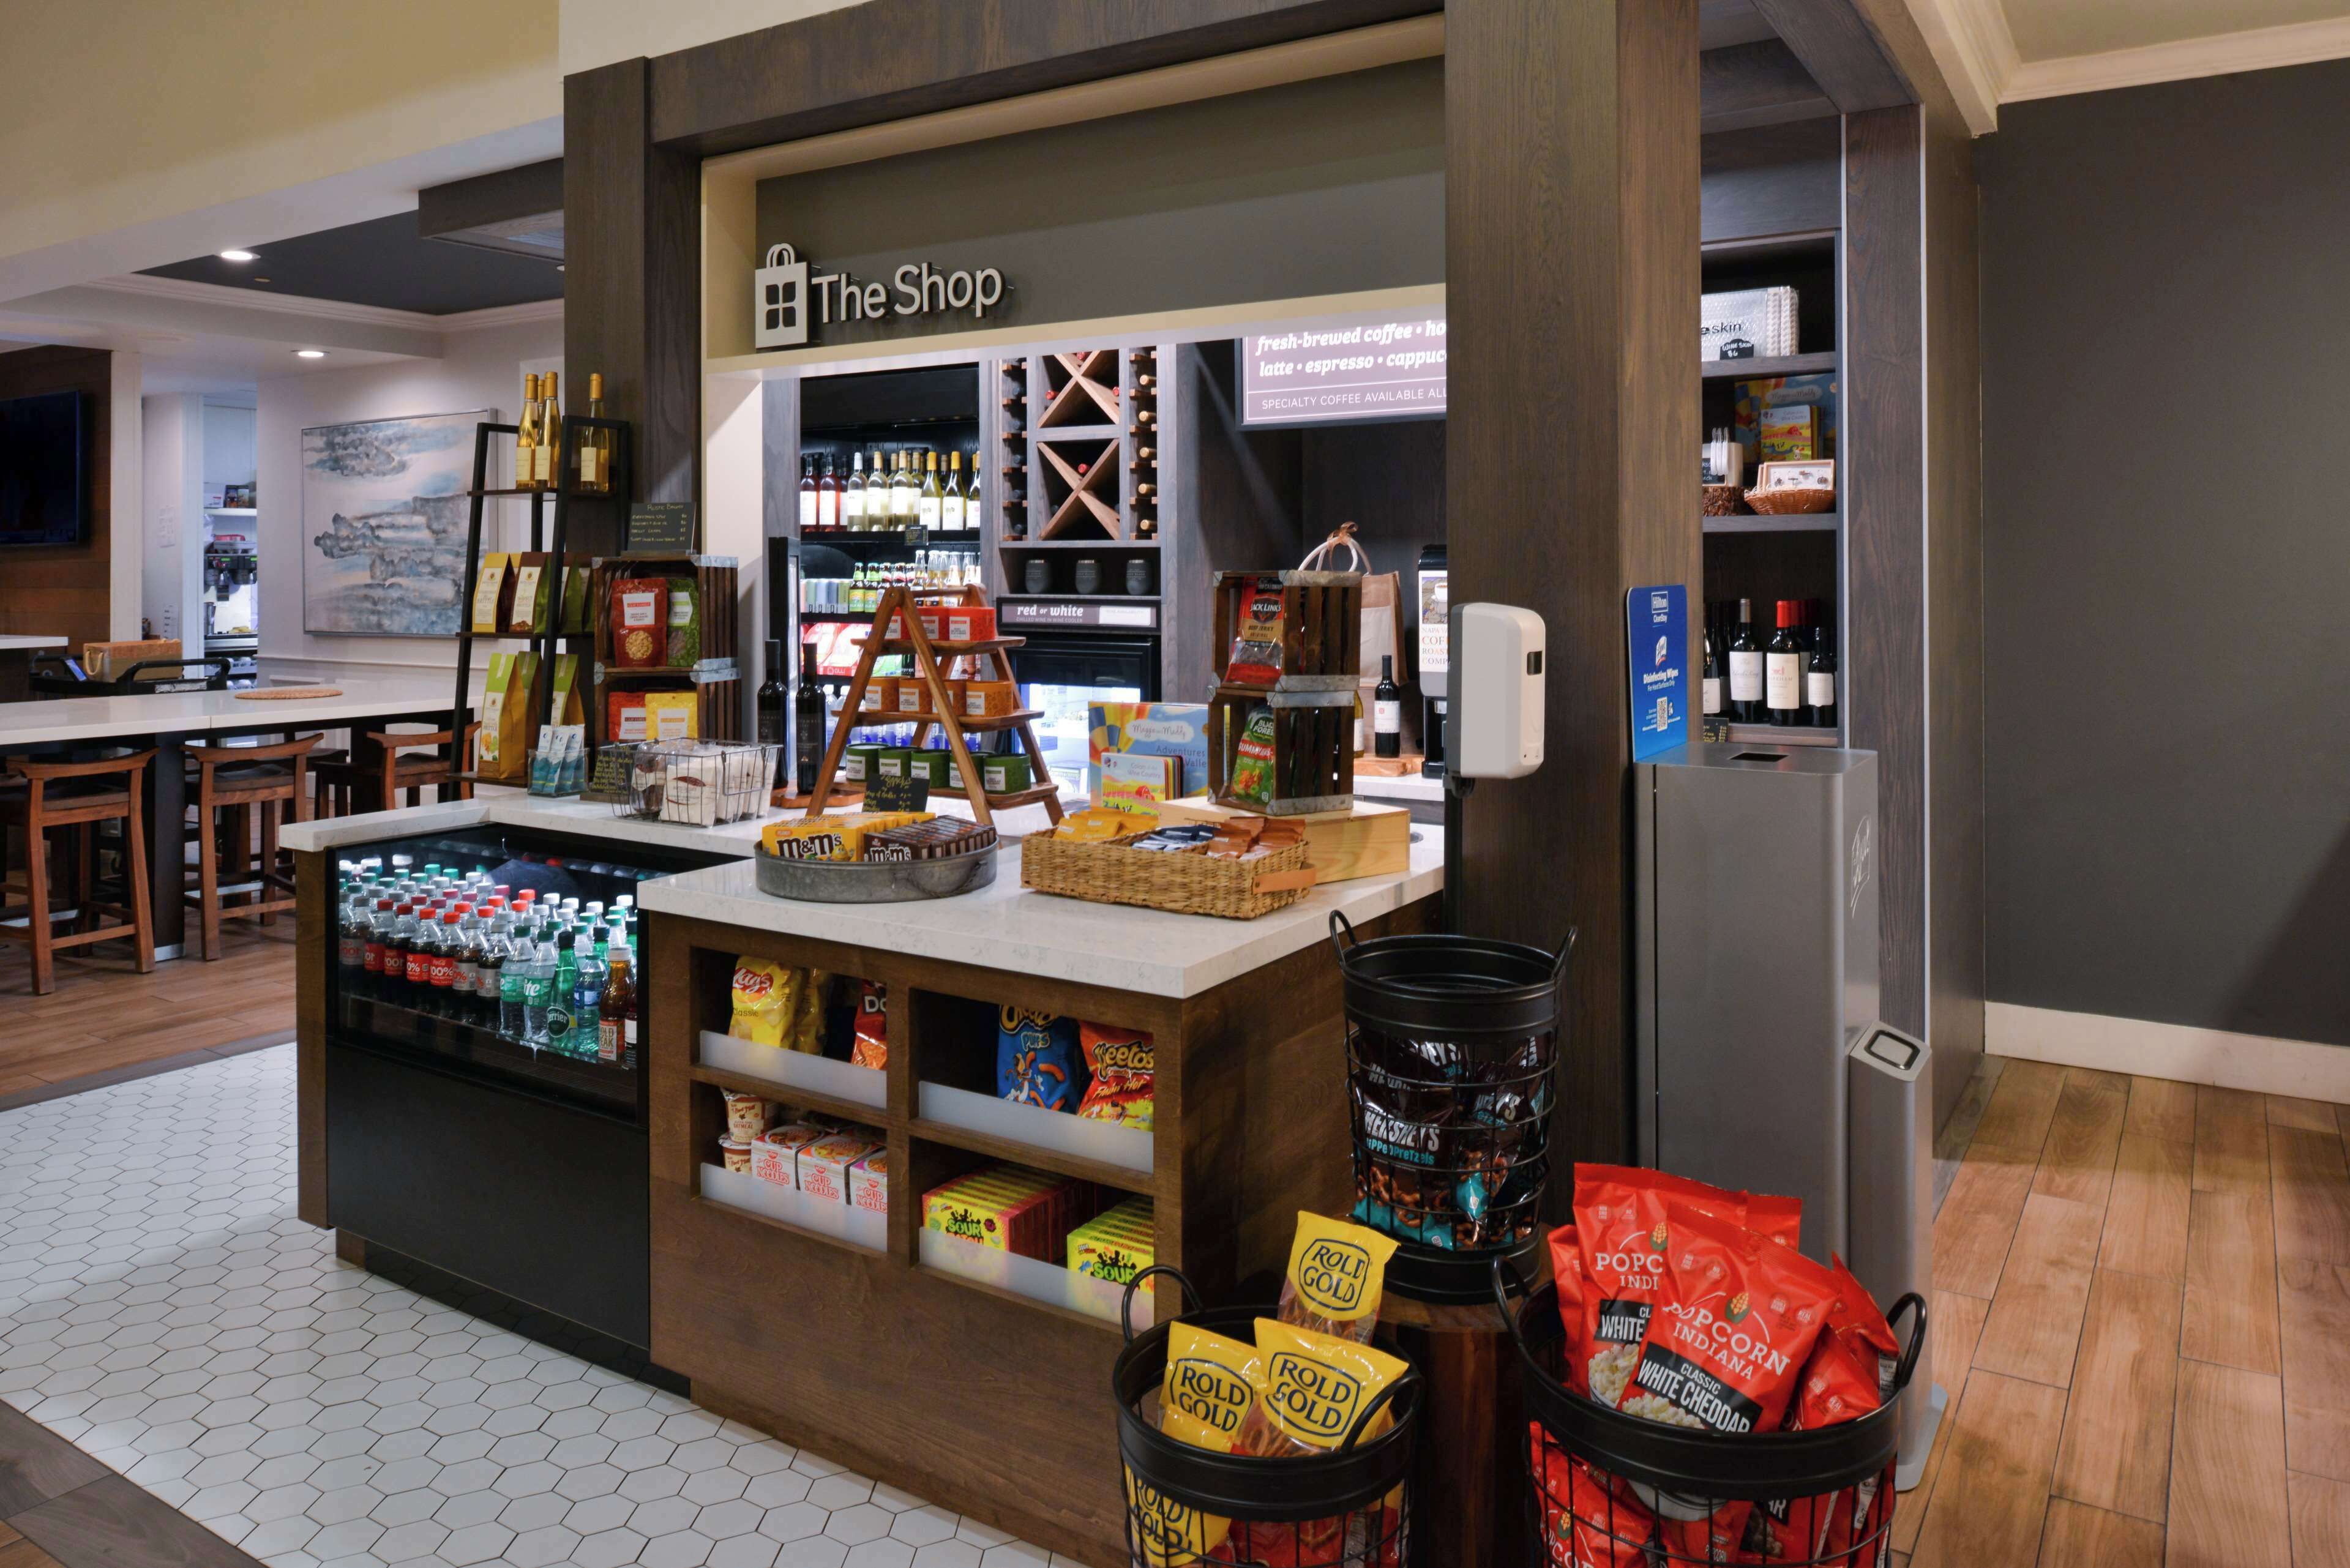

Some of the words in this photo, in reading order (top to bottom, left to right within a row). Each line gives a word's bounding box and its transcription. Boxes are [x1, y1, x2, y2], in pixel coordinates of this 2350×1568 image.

[811, 273, 887, 323] The
[894, 262, 1003, 318] Shop
[1255, 327, 1361, 356] fresh-brewed
[1364, 323, 1412, 345] coffee
[1260, 361, 1293, 376] latte
[1305, 354, 1374, 375] espresso
[1386, 349, 1447, 367] cappuc
[1262, 397, 1316, 409] SPECIALTY
[1320, 394, 1361, 405] COFFEE
[1365, 389, 1424, 402] AVAILABLE
[1428, 387, 1447, 397] ALL
[1017, 603, 1037, 616] red
[1050, 605, 1083, 616] white
[1250, 603, 1263, 612] JACK
[1653, 596, 1666, 609] Hilton
[1644, 671, 1666, 684] Disinfecting
[1666, 668, 1678, 679] Wipes
[1156, 745, 1205, 757] Adventures
[523, 979, 540, 996] ite
[732, 968, 771, 994] Lay's
[733, 1007, 759, 1018] Classic
[756, 1165, 790, 1185] NOODLES
[764, 1158, 783, 1171] CUP
[804, 1179, 840, 1200] NOODLES
[811, 1173, 831, 1186] CUP
[863, 1186, 884, 1200] CUP
[948, 1218, 981, 1238] SOUR
[1312, 1245, 1364, 1279] ROLD
[1595, 1252, 1663, 1274] POPC
[1303, 1266, 1356, 1304] GOLD
[1620, 1275, 1658, 1290] INDI
[1639, 1307, 1652, 1318] CL
[1601, 1314, 1644, 1340] WHITE
[1663, 1302, 1791, 1376] POPCORN
[1673, 1322, 1753, 1381] INDIANA
[1180, 1365, 1246, 1406] ROLD
[1279, 1358, 1352, 1404] ROLD
[1637, 1359, 1678, 1399] WHITE
[1680, 1363, 1721, 1395] CLASSIC
[1178, 1392, 1239, 1432] GOLD
[1275, 1383, 1342, 1429] GOLD
[1683, 1375, 1751, 1433] CHEDDAR
